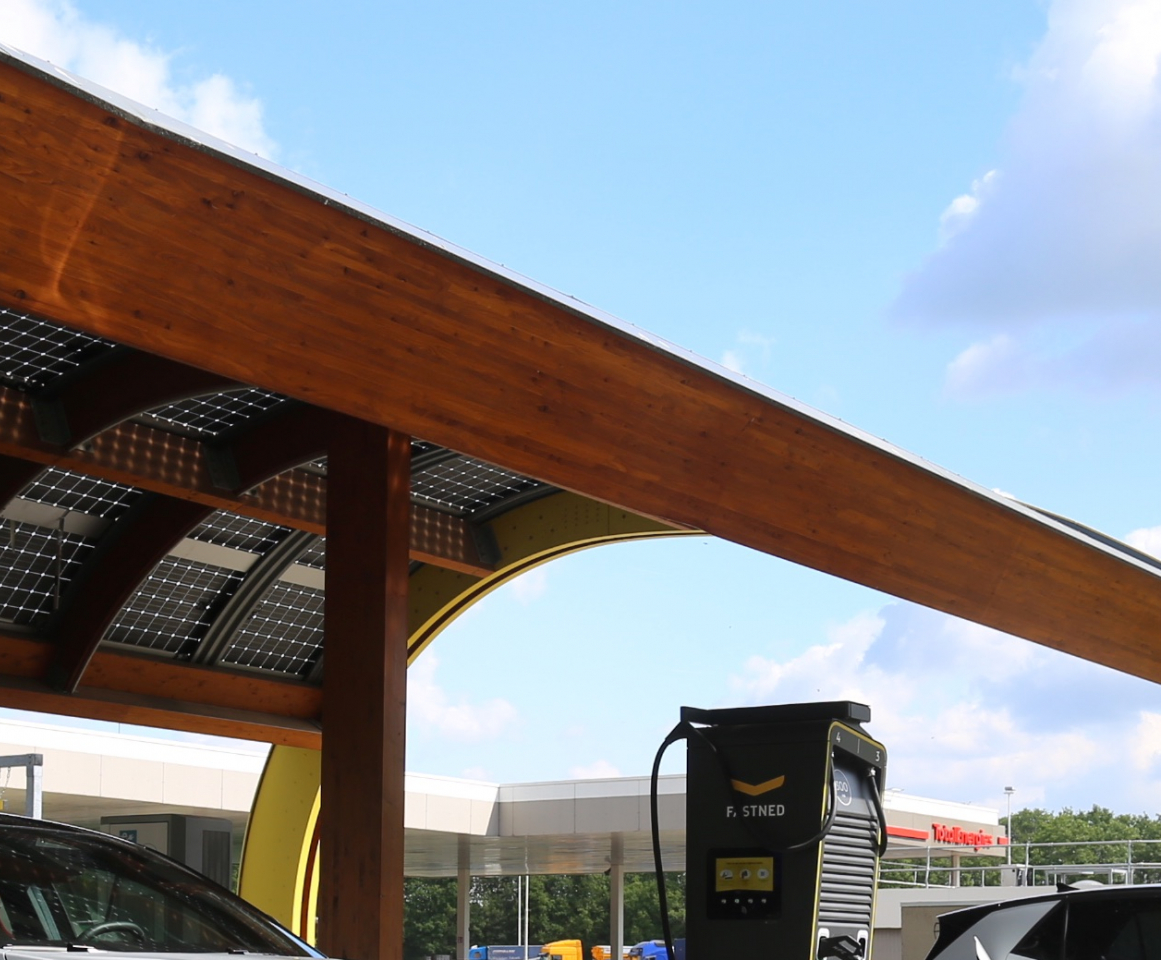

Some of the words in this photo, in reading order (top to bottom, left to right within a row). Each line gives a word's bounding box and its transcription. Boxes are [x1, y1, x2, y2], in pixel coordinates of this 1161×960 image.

[835, 731, 842, 743] 4
[874, 750, 881, 762] 3
[726, 804, 785, 818] FSTNED
[932, 822, 993, 852] TotalEnergies
